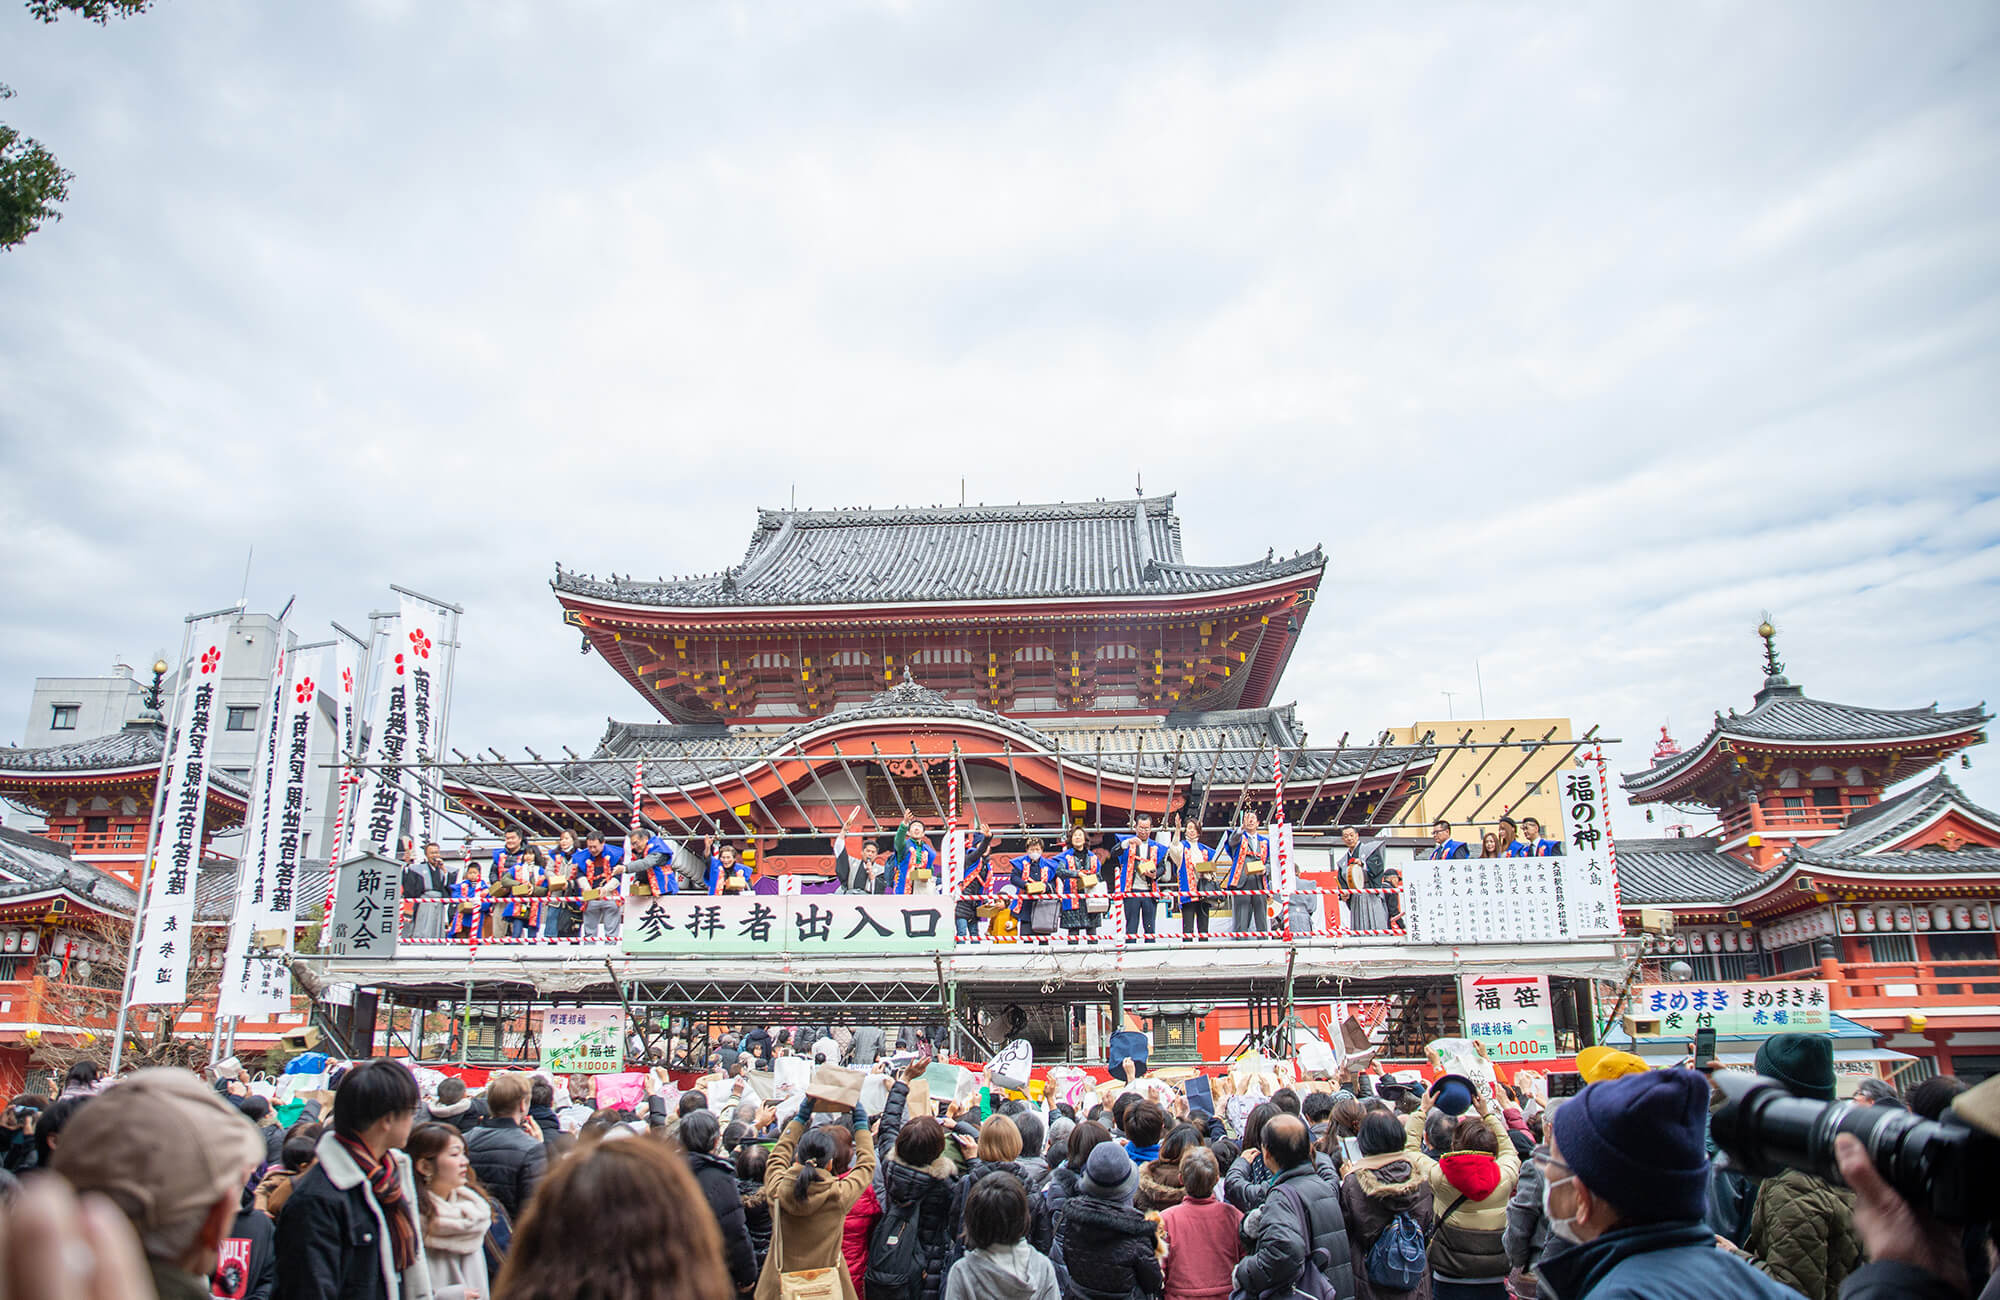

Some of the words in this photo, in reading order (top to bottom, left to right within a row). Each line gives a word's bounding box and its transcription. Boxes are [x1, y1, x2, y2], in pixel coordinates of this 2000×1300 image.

[1566, 775, 1601, 851] 福の神
[1588, 858, 1602, 885] 大島
[350, 869, 383, 949] 節分会
[382, 875, 397, 933] 二月三日
[637, 902, 942, 943] 参拝者出入口
[1474, 986, 1541, 1011] 福笹
[1650, 988, 1729, 1012] まめまき
[1742, 987, 1825, 1008] まめまき券
[550, 1014, 586, 1025] 開運招福
[1471, 1021, 1513, 1036] 開運招福
[1665, 1012, 1714, 1029] 受付
[1753, 1009, 1789, 1025] 売場
[590, 1044, 617, 1058] 福笹
